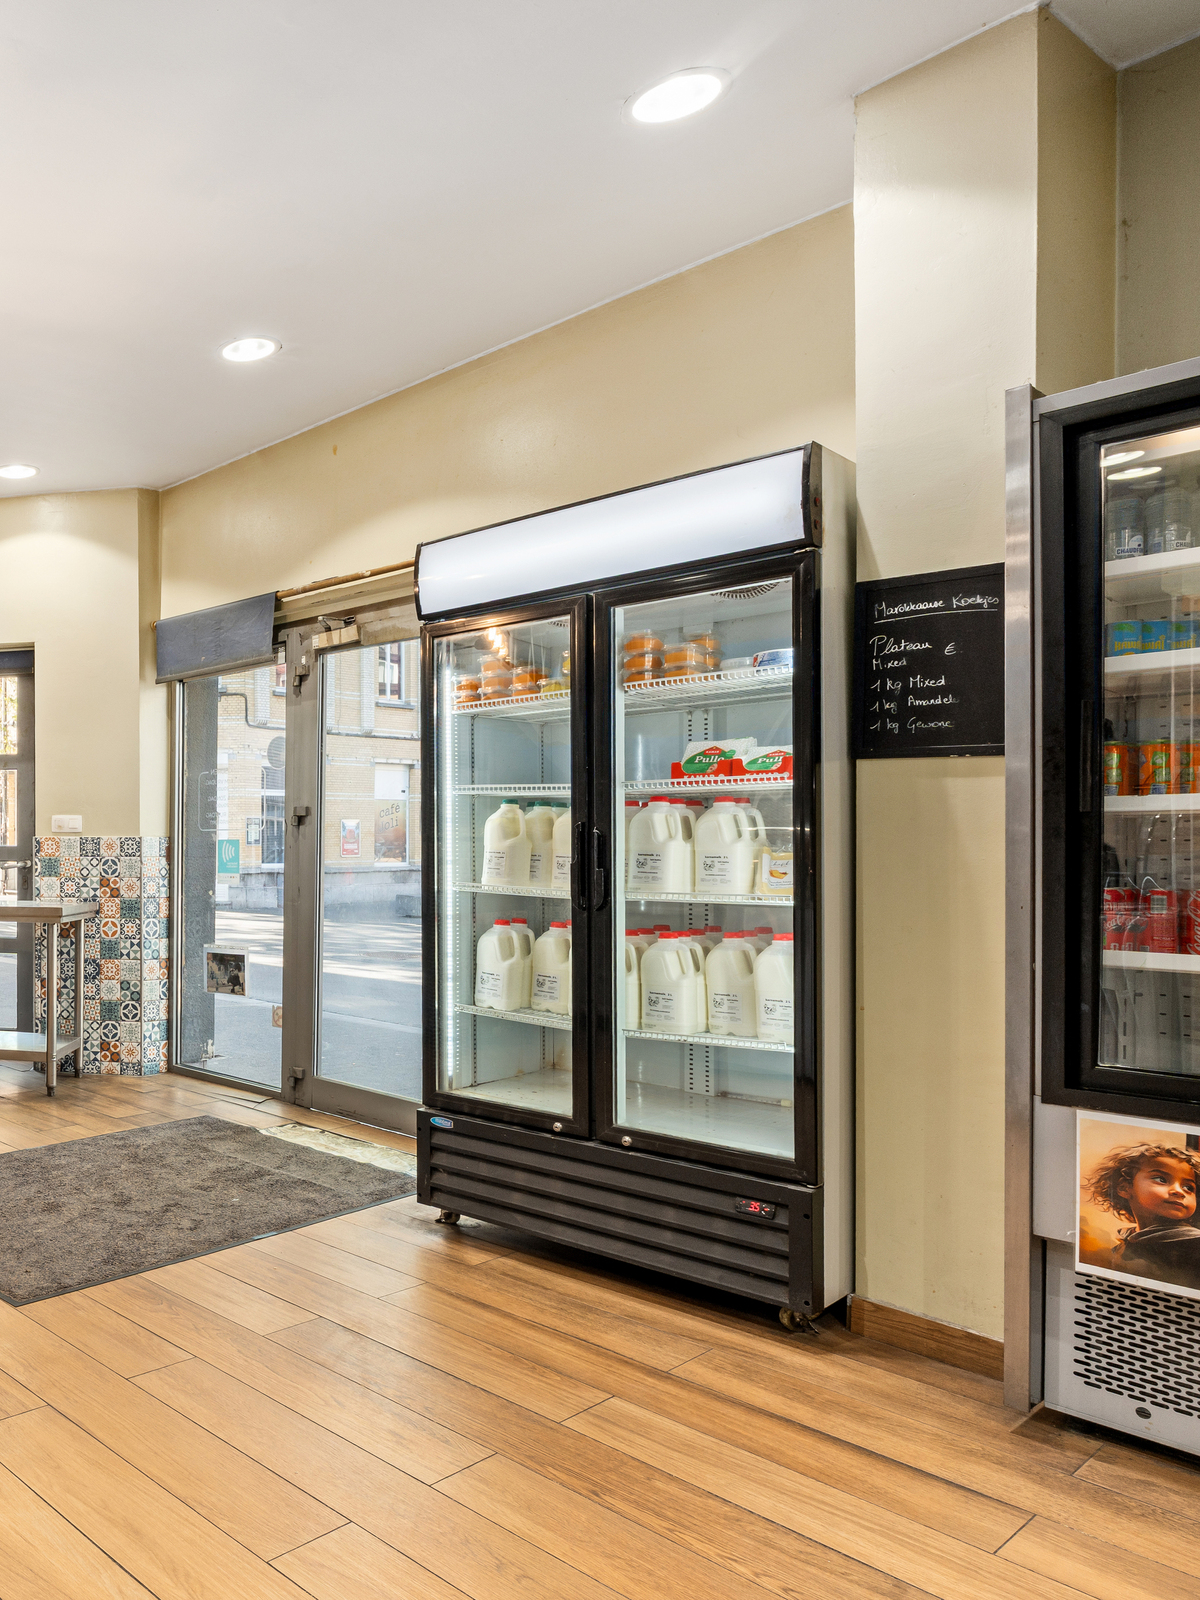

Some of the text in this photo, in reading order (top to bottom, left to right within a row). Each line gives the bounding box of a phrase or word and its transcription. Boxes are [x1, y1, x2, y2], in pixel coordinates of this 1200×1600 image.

[869, 635, 957, 656] Plateau €
[872, 657, 907, 670] Mixed
[870, 674, 946, 695] 1 kg Mixed
[869, 701, 880, 713] 1
[882, 699, 898, 715] kg
[869, 720, 881, 732] 1
[886, 718, 899, 734] kg
[757, 755, 783, 764] Pull
[379, 802, 401, 818] café
